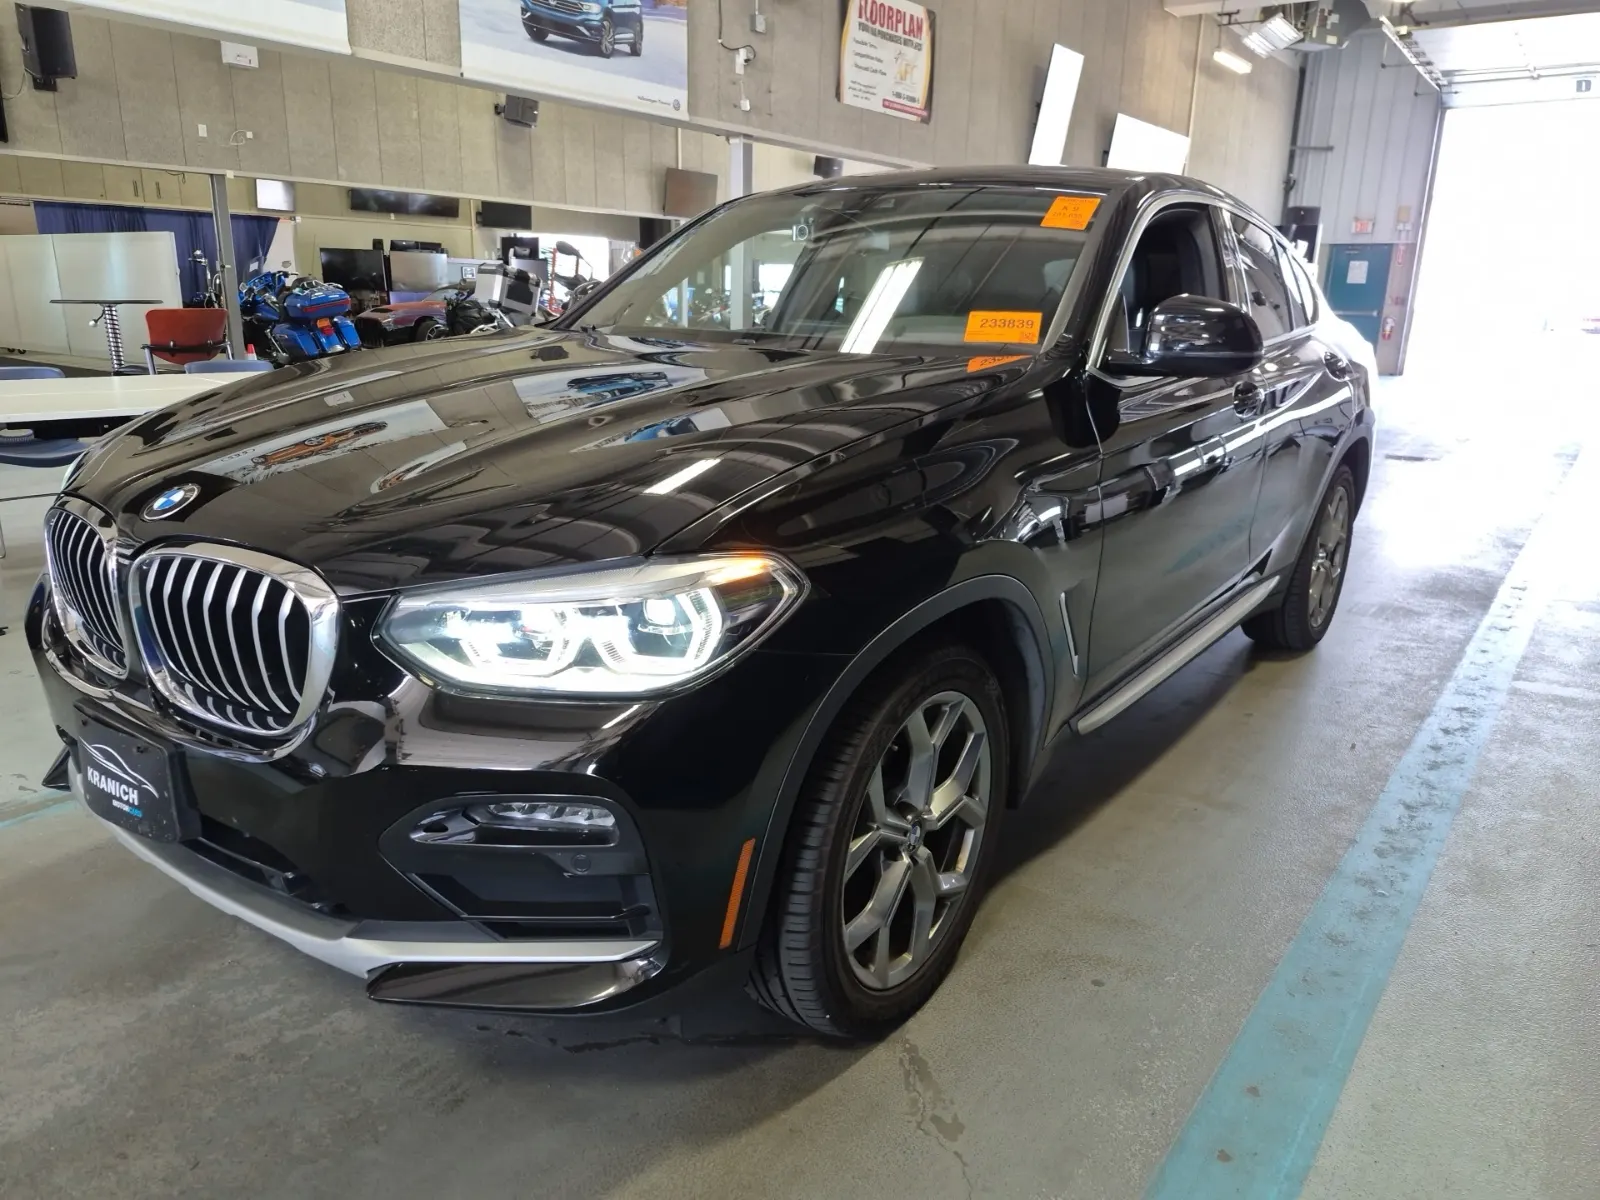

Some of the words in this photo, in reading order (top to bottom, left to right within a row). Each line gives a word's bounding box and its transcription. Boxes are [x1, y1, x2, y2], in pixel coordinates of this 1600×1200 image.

[857, 0, 924, 40] FLOORPLAN
[979, 318, 1035, 329] 233839
[87, 765, 139, 806] KRANICH
